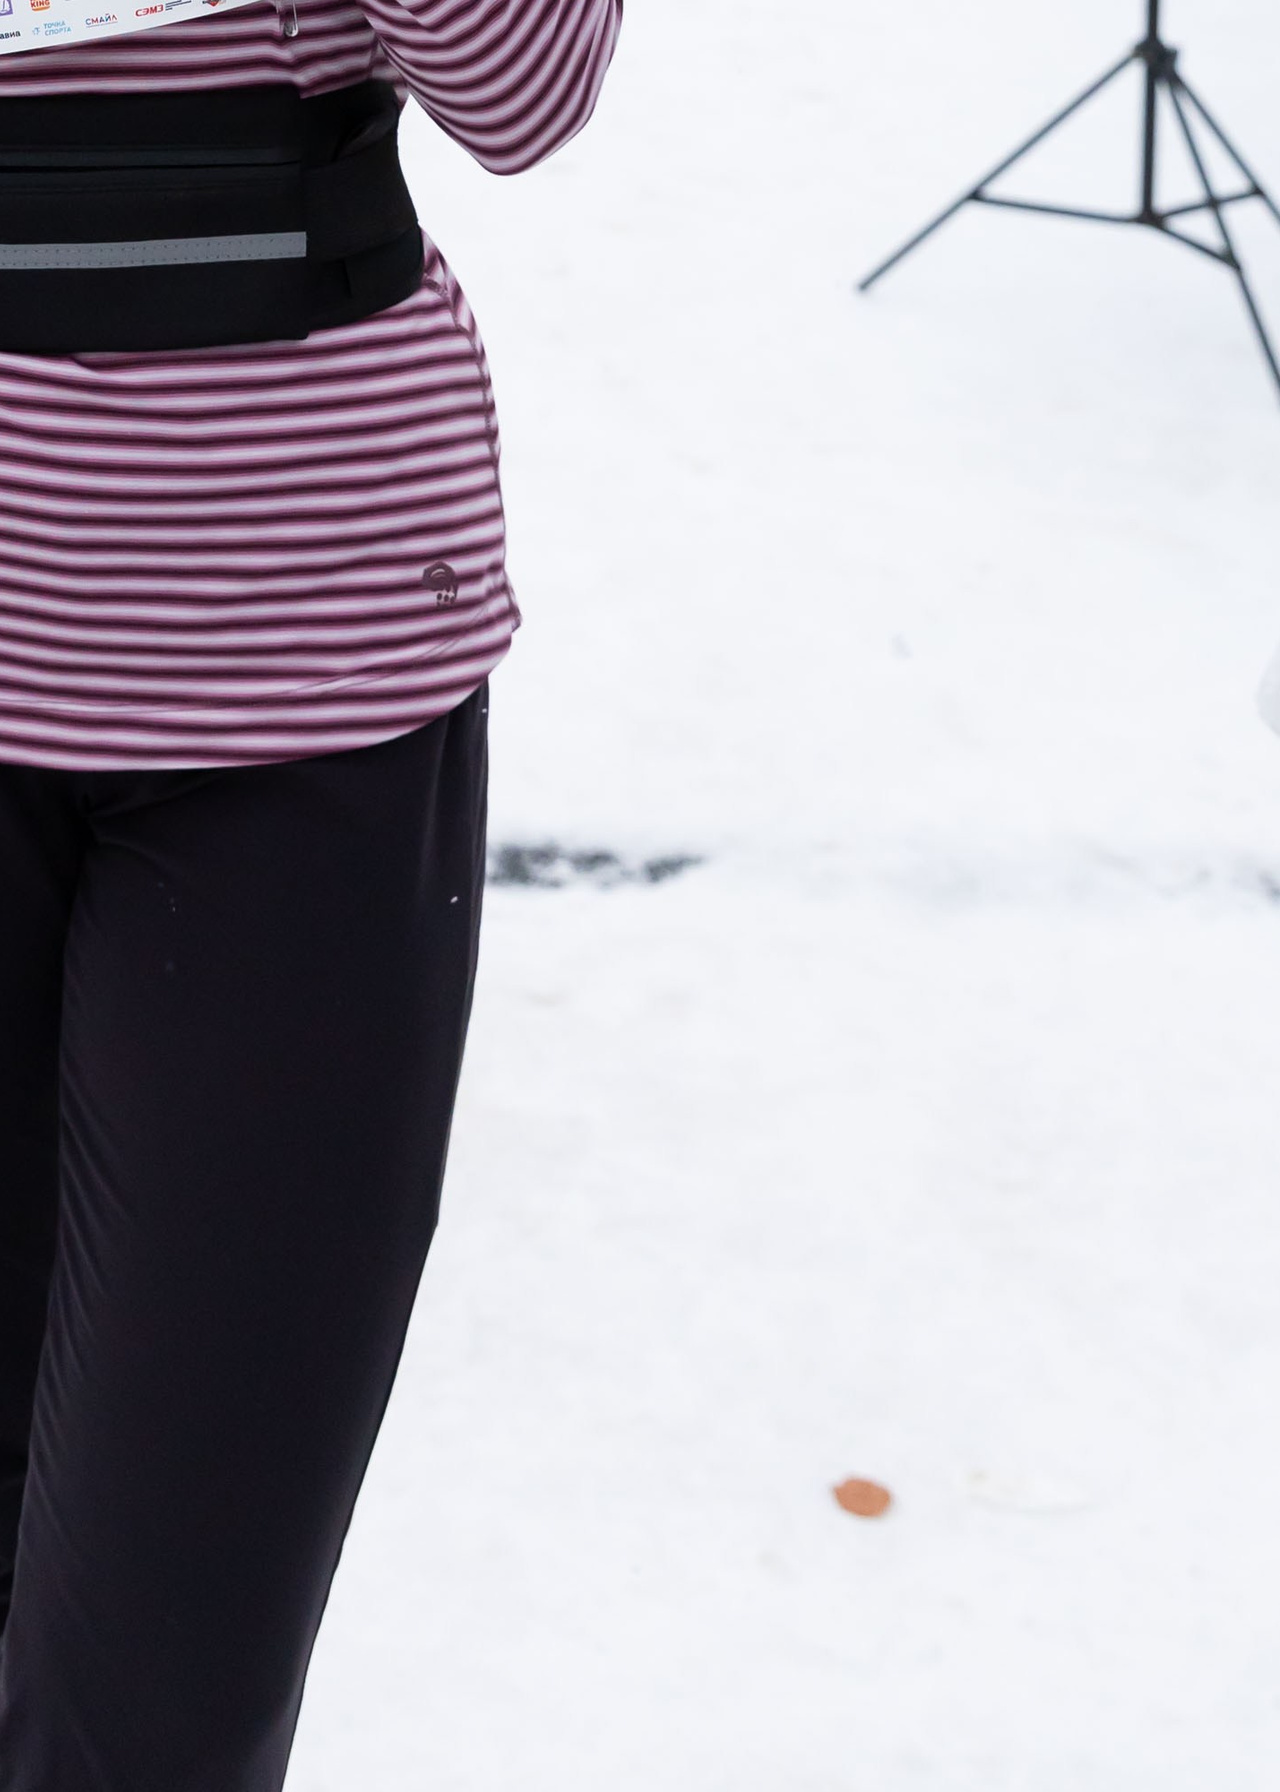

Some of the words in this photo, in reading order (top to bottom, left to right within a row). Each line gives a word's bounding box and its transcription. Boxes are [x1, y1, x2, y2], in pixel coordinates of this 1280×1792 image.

[30, 0, 50, 8] KING
[135, 3, 164, 17] СЭМЗ
[43, 20, 66, 29] ТОЧКА
[44, 27, 72, 36] СПОРТА
